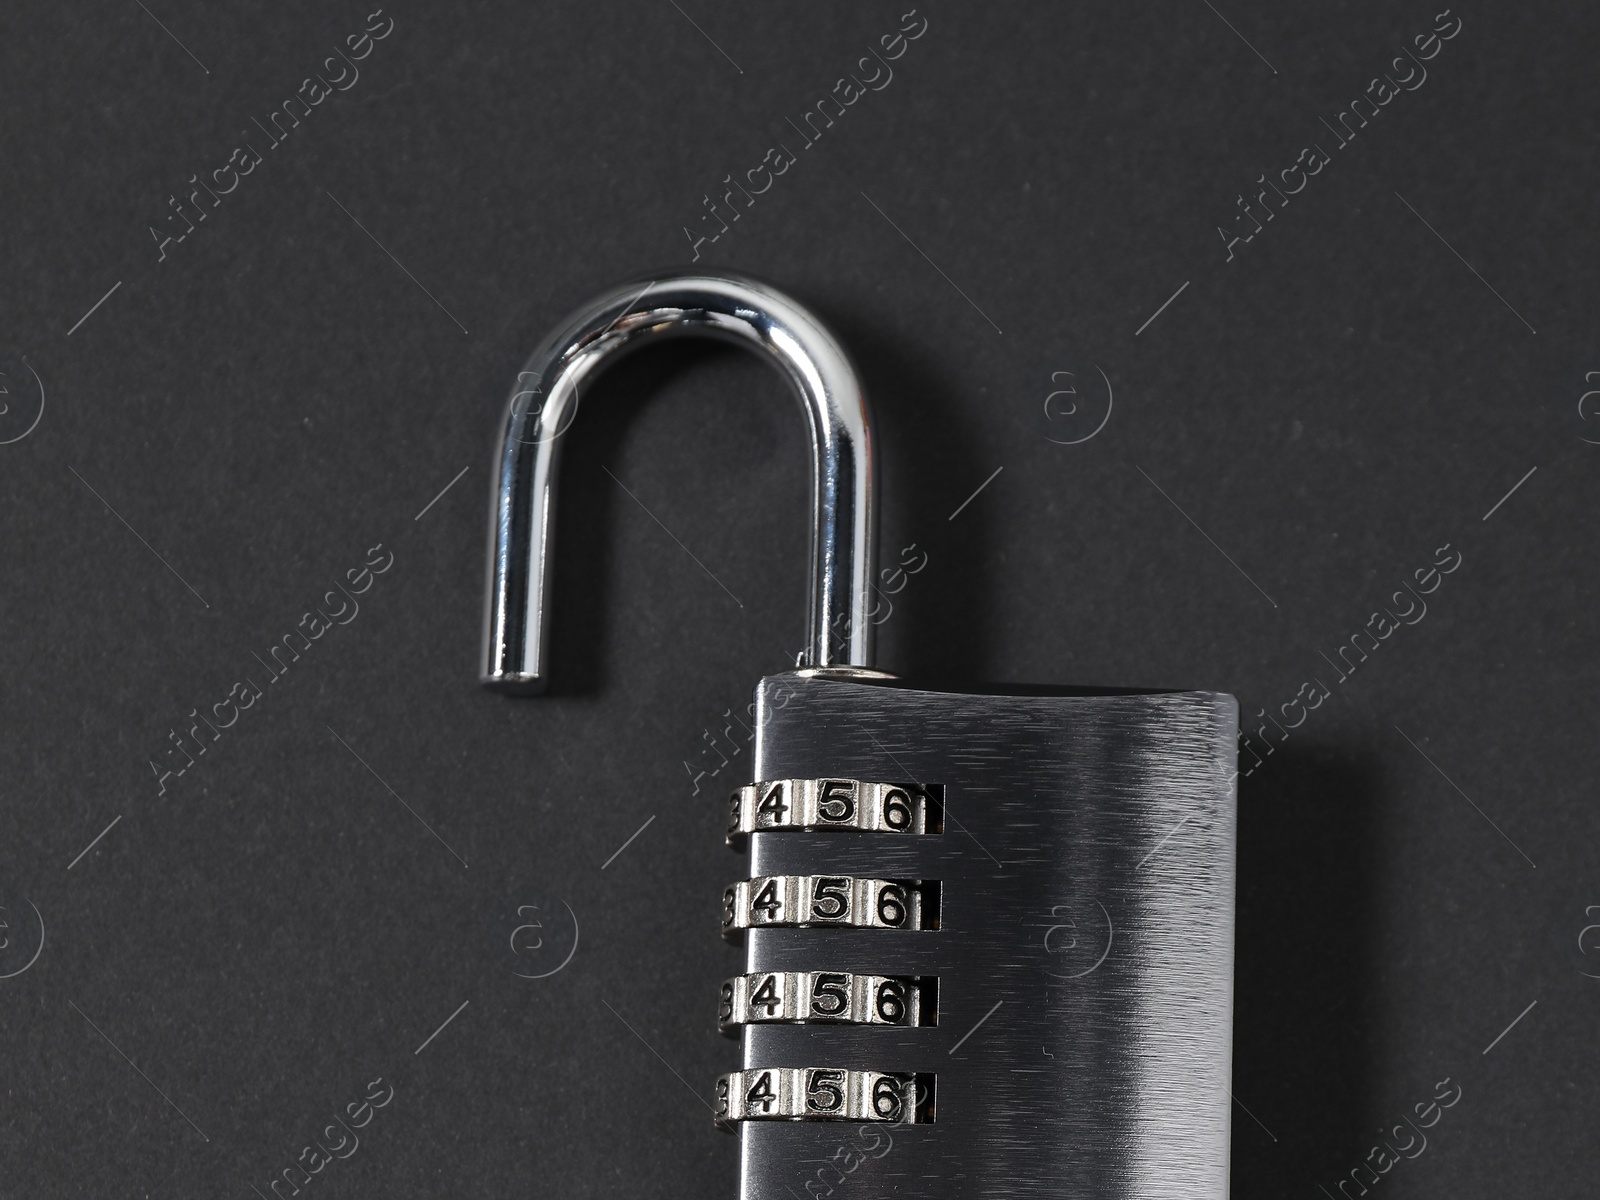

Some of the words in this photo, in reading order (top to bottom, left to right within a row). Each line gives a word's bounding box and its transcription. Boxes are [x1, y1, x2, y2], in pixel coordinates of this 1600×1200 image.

[759, 784, 788, 824] 4
[818, 781, 854, 823] 5
[884, 788, 913, 831] 6
[753, 880, 781, 919] 4
[813, 878, 848, 919] 5
[878, 884, 907, 927] 6
[752, 976, 781, 1016] 4
[811, 974, 848, 1016] 5
[877, 980, 906, 1022] 6
[747, 1072, 776, 1112] 4
[807, 1071, 845, 1113] 5
[873, 1076, 902, 1118] 6
